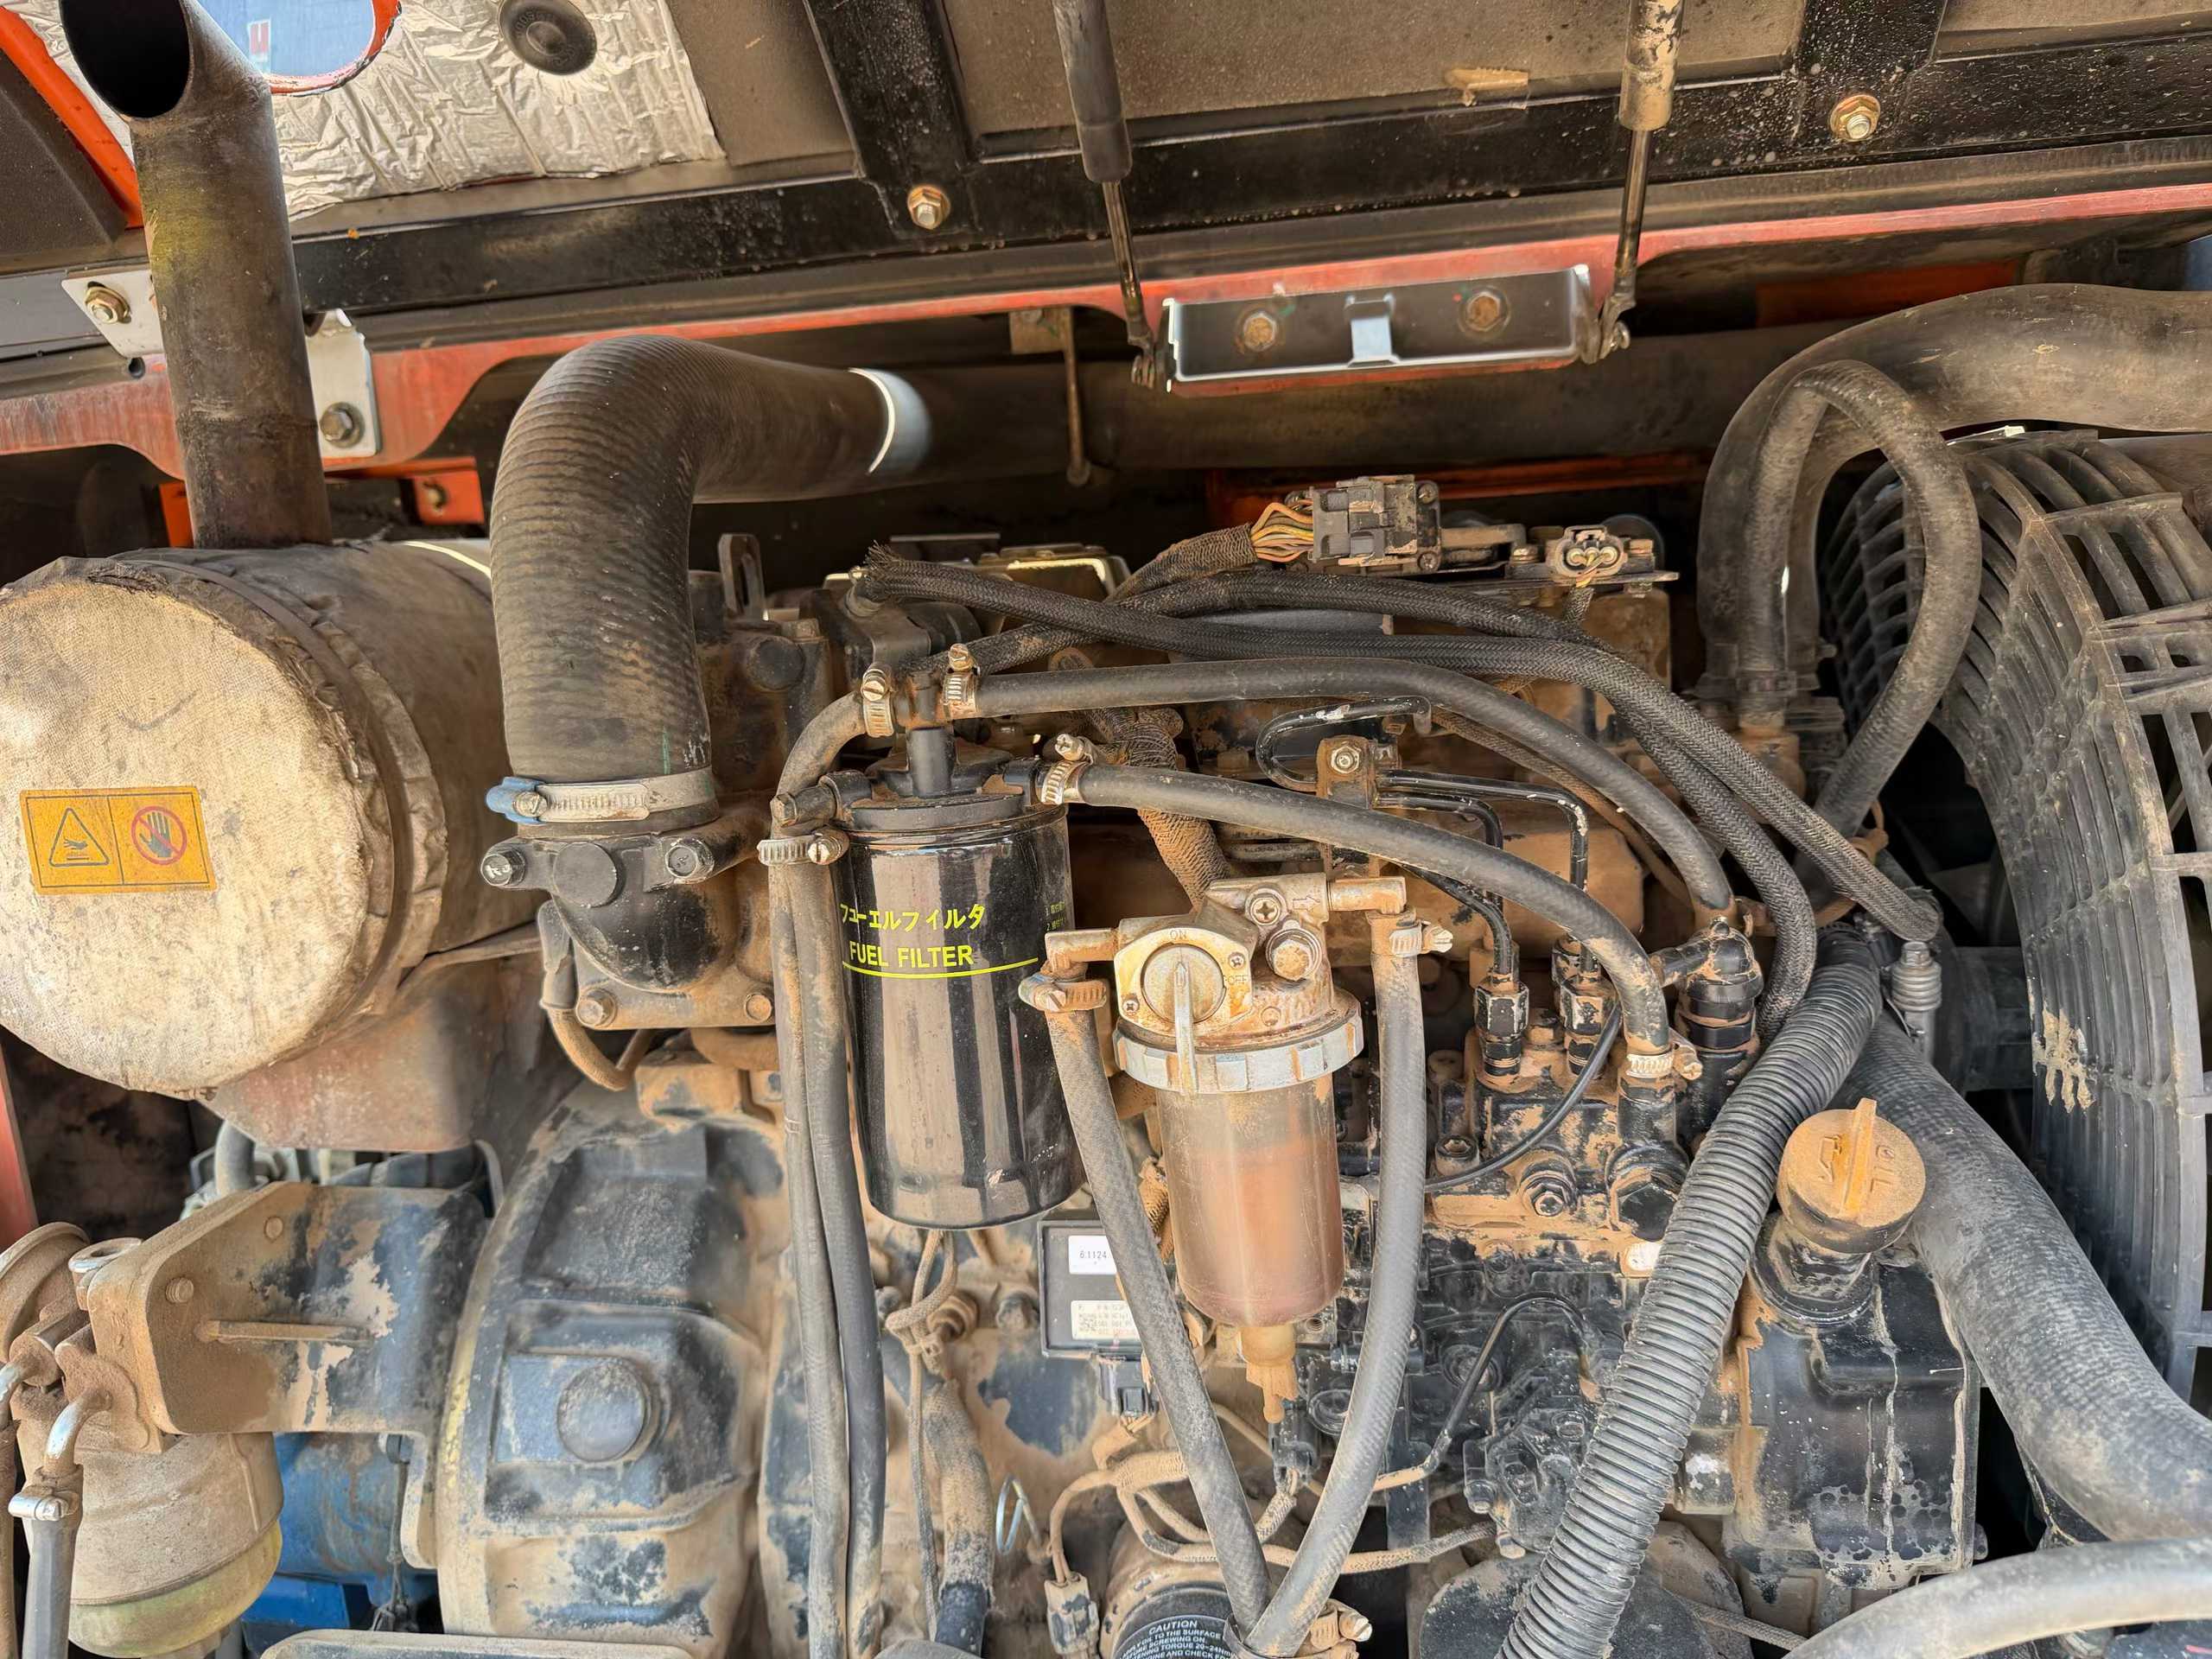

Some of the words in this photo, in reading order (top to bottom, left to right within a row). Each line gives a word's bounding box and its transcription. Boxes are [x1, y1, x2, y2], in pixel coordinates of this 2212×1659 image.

[840, 903, 985, 932] フューエルフィルタ
[1169, 928, 1188, 940] ON
[849, 940, 889, 967] FUEL
[898, 944, 974, 969] FILTER
[1870, 1144, 1895, 1193] OIL
[1149, 1620, 1198, 1635] CAUTION
[1183, 1629, 1222, 1639] SURFACE
[1149, 1636, 1192, 1648] SCREWING
[1160, 1642, 1194, 1651] TORQUE
[1185, 1649, 1214, 1659] CHECK
